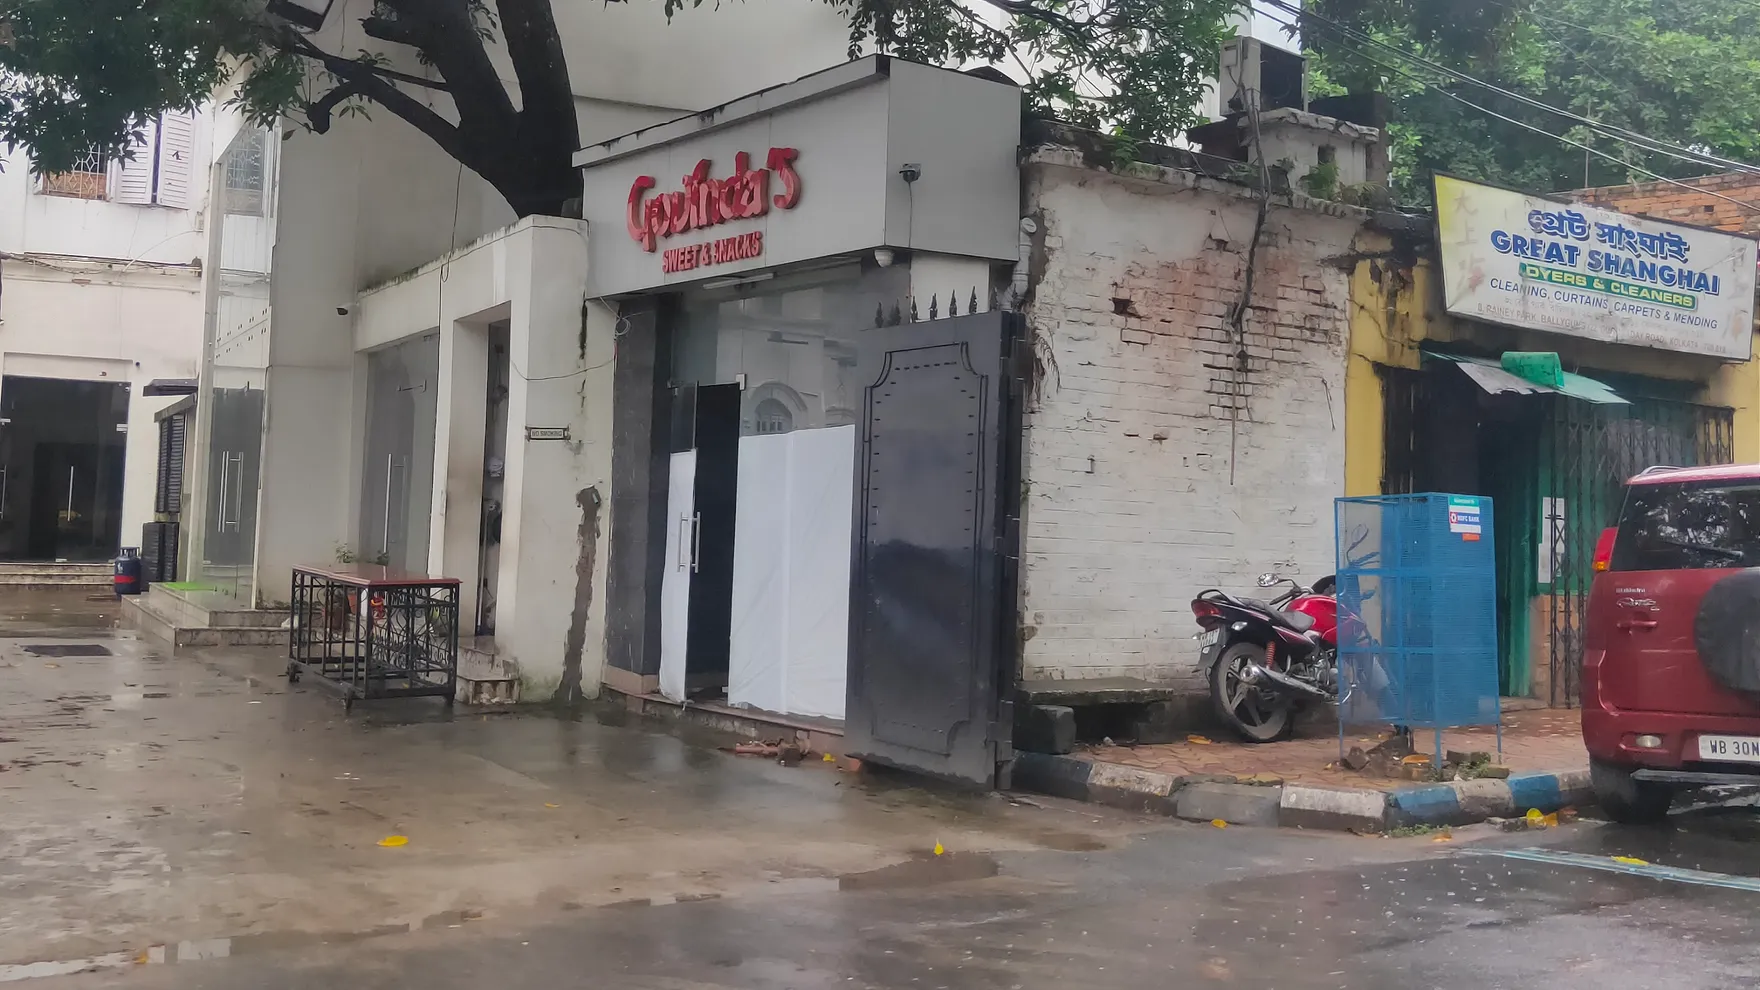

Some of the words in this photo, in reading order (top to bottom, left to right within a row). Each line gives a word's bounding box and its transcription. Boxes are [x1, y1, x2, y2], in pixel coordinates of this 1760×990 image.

[662, 244, 700, 273] SWEET
[701, 242, 711, 266] &
[713, 231, 762, 262] SNACKS
[1490, 230, 1580, 268] GREAT
[1587, 250, 1720, 296] SHANGHAI
[1525, 266, 1587, 286] DYERS
[1593, 277, 1605, 289] &
[1611, 282, 1693, 307] CLEANERS
[1614, 301, 1661, 318] CARPETS
[1664, 311, 1671, 321] &
[1674, 313, 1718, 329] MENDING
[1710, 740, 1727, 755] WB
[1733, 741, 1760, 757] 30N
